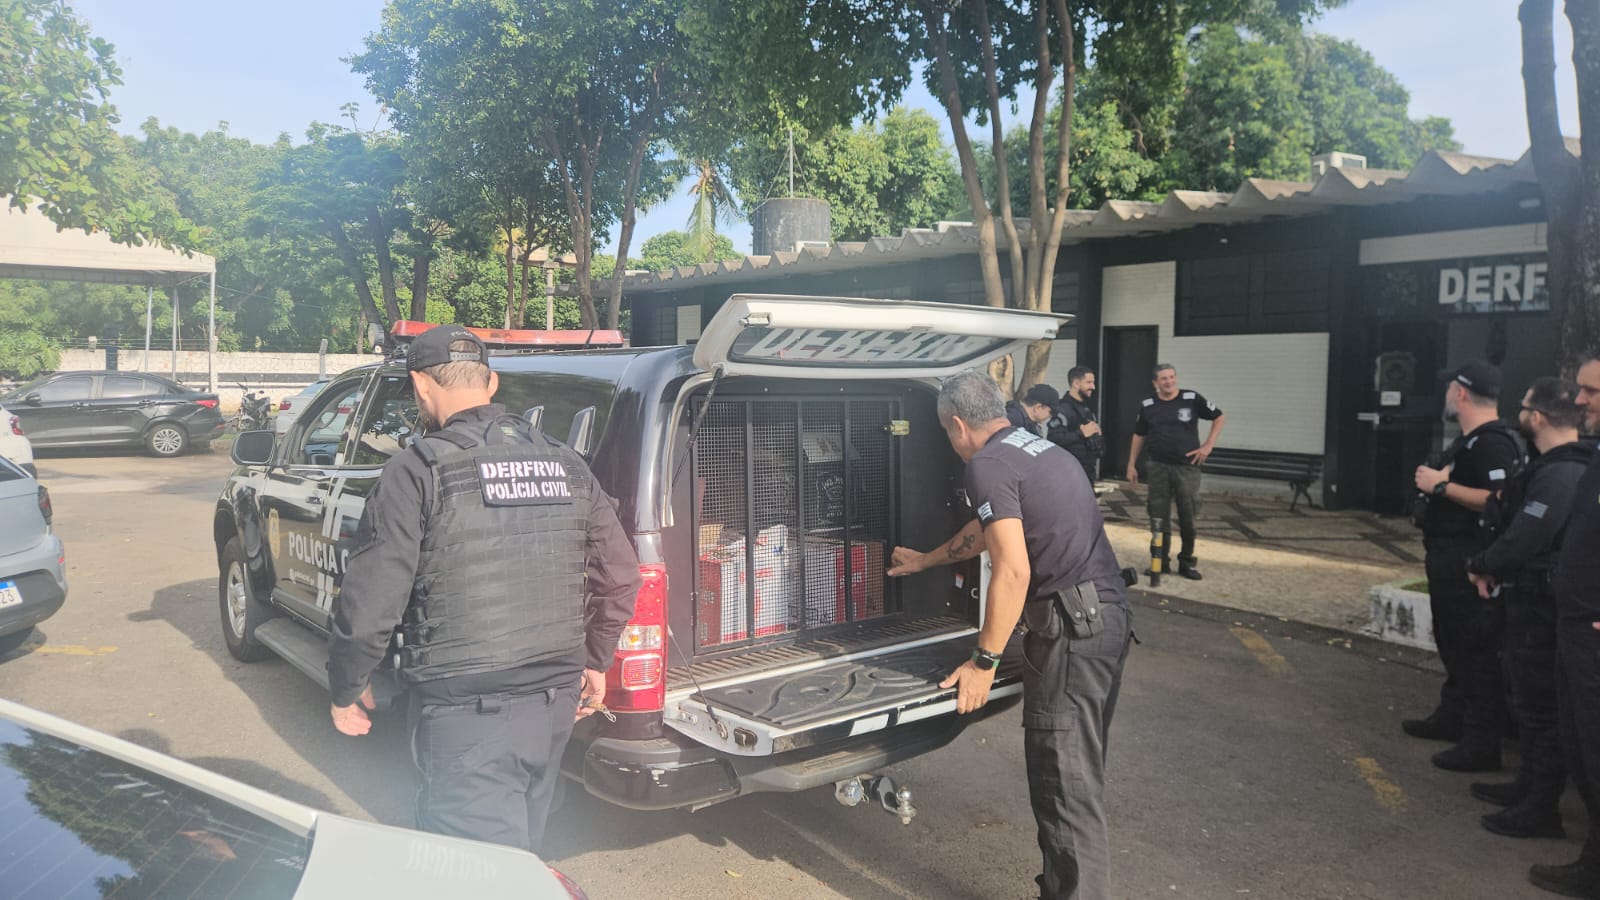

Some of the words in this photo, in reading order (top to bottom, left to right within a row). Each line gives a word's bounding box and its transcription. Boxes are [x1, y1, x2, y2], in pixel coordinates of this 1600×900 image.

[480, 461, 566, 479] DERFRVA
[486, 478, 540, 500] POLÍCIA
[541, 481, 571, 497] CIVIL
[288, 531, 339, 574] POLÍCIA
